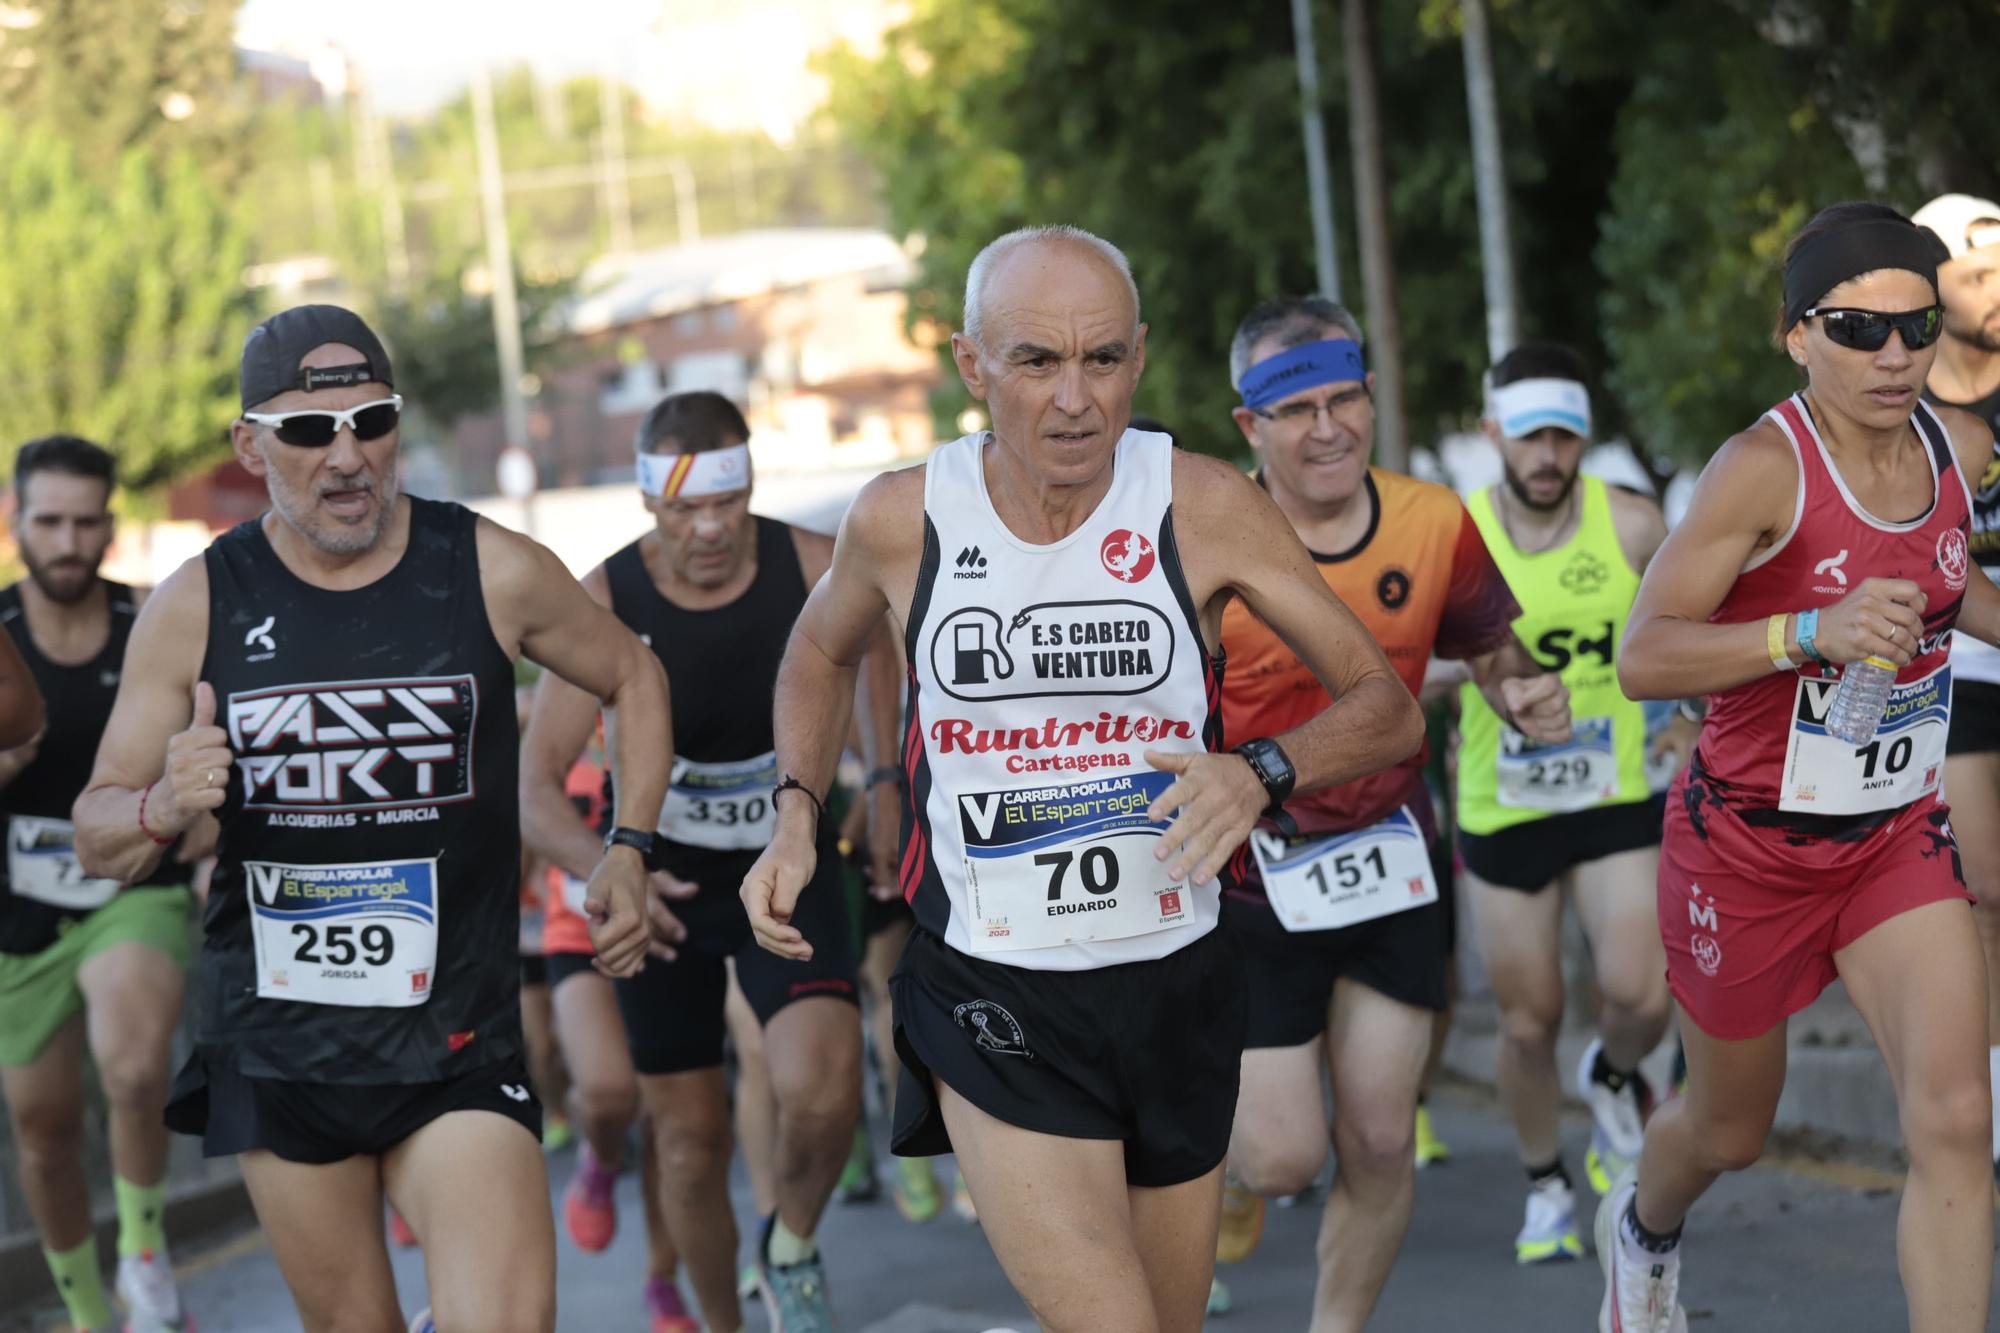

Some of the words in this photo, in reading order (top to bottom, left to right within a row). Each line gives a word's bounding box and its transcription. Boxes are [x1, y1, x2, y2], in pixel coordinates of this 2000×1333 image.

[953, 569, 988, 580] mobel
[1032, 624, 1063, 647] E.S
[1069, 619, 1151, 646] CABEZO
[1032, 648, 1154, 679] VENTURA
[1804, 681, 1837, 720] V
[1882, 686, 1938, 720] parragal
[1900, 678, 1935, 700] POPULAR
[930, 711, 1196, 755] Runtriton
[236, 743, 454, 801] PORT
[1005, 751, 1132, 774] Cartagena
[1526, 757, 1590, 786] 229
[1855, 736, 1913, 779] 10
[1862, 779, 1894, 791] ANITA
[267, 812, 357, 828] ALQUERIAS
[377, 806, 440, 825] MURCIA
[685, 796, 767, 827] 330
[960, 793, 1002, 841] V
[1003, 787, 1071, 805] CARRERA
[1071, 777, 1133, 798] POPULAR
[1005, 803, 1028, 824] El
[1032, 788, 1151, 824] Esparragal
[252, 865, 283, 905] V
[283, 868, 337, 882] CARRERA
[337, 867, 393, 881] POPULAR
[1034, 846, 1120, 901] 70
[1305, 845, 1387, 895] 151
[284, 880, 301, 896] El
[303, 878, 409, 902] Esparragal
[1047, 898, 1118, 917] EDUARDO
[291, 924, 395, 967] 259
[988, 929, 1010, 937] 2023
[320, 969, 368, 980] JOROSA
